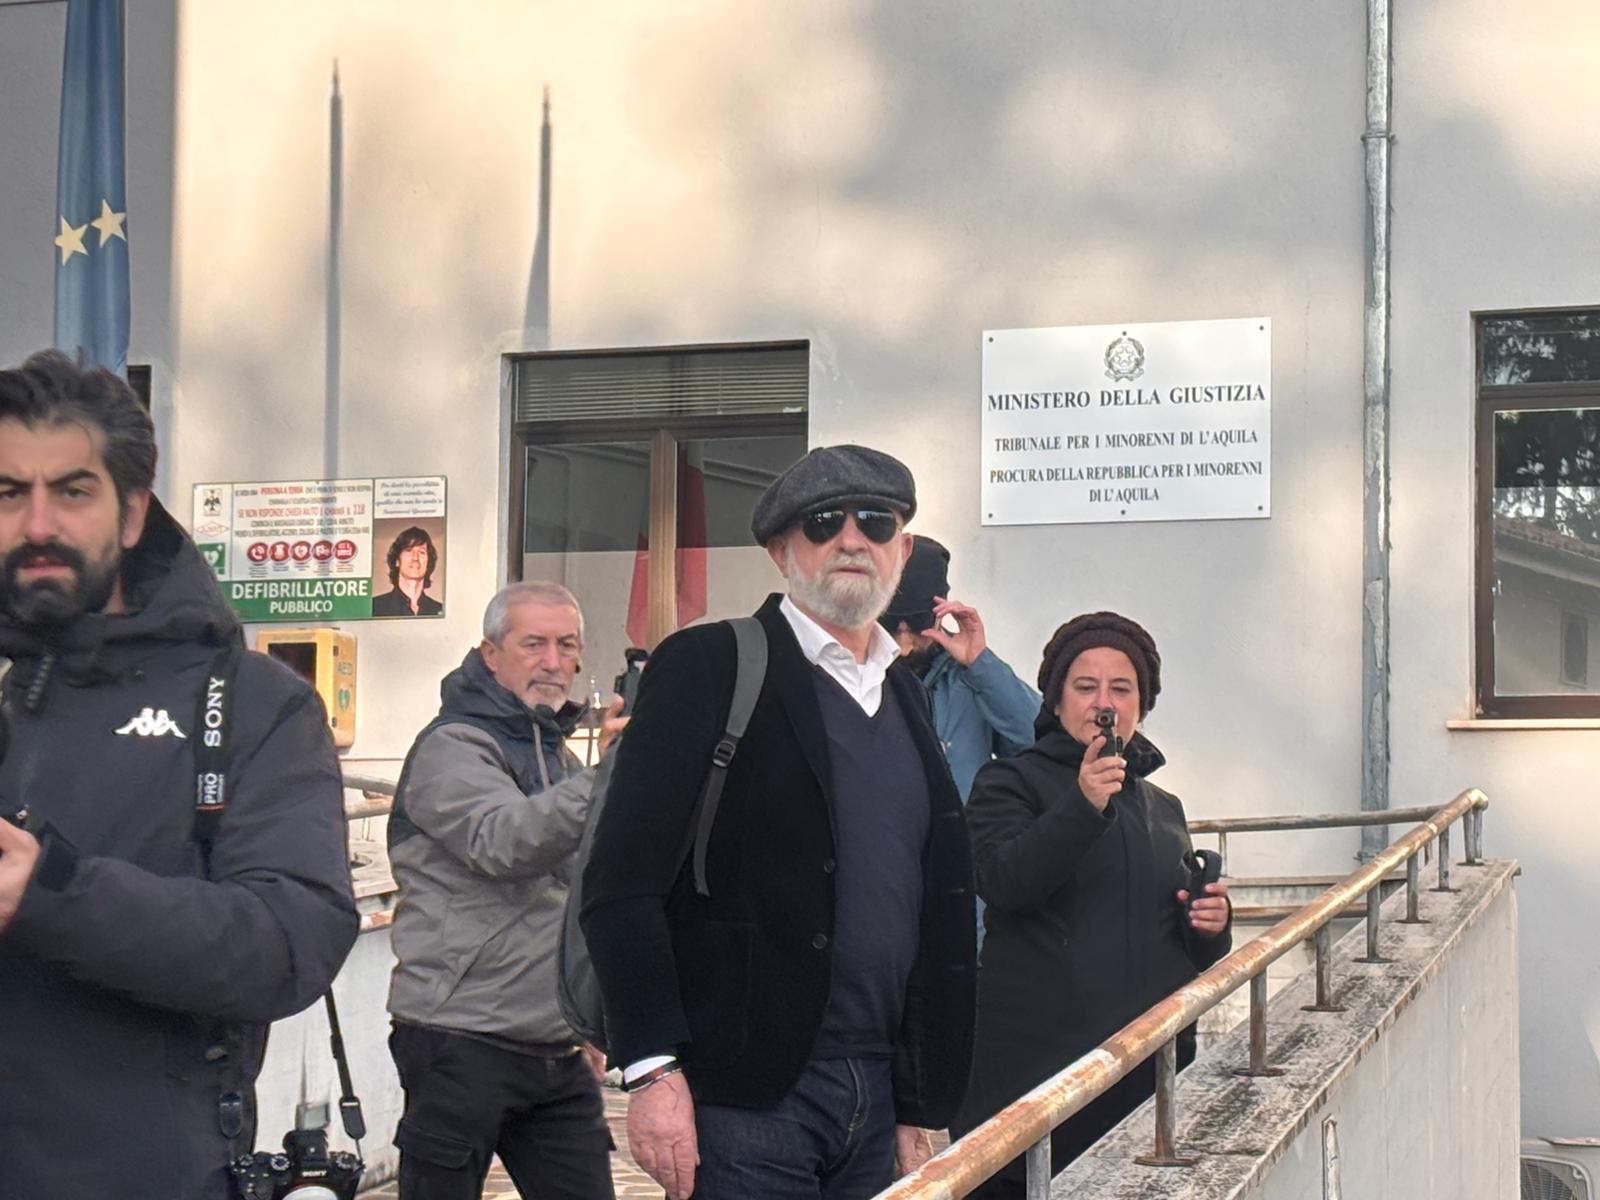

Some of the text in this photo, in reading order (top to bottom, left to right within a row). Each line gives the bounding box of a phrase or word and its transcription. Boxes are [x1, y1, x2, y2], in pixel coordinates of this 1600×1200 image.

[987, 384, 1266, 411] MINISTERO DELLA GIUSTIZIA
[995, 429, 1258, 452] TRIBUNALE PER I MINORENNI DI L'AQUILA
[989, 460, 1263, 484] PROCURA DELLA REPUBBLICA PER I MINORENNI
[1089, 488, 1101, 503] DI
[231, 580, 368, 599] DEFIBRILLATORE
[269, 600, 333, 614] PUBBLICO
[203, 677, 226, 748] SONY
[203, 772, 218, 804] PRO
